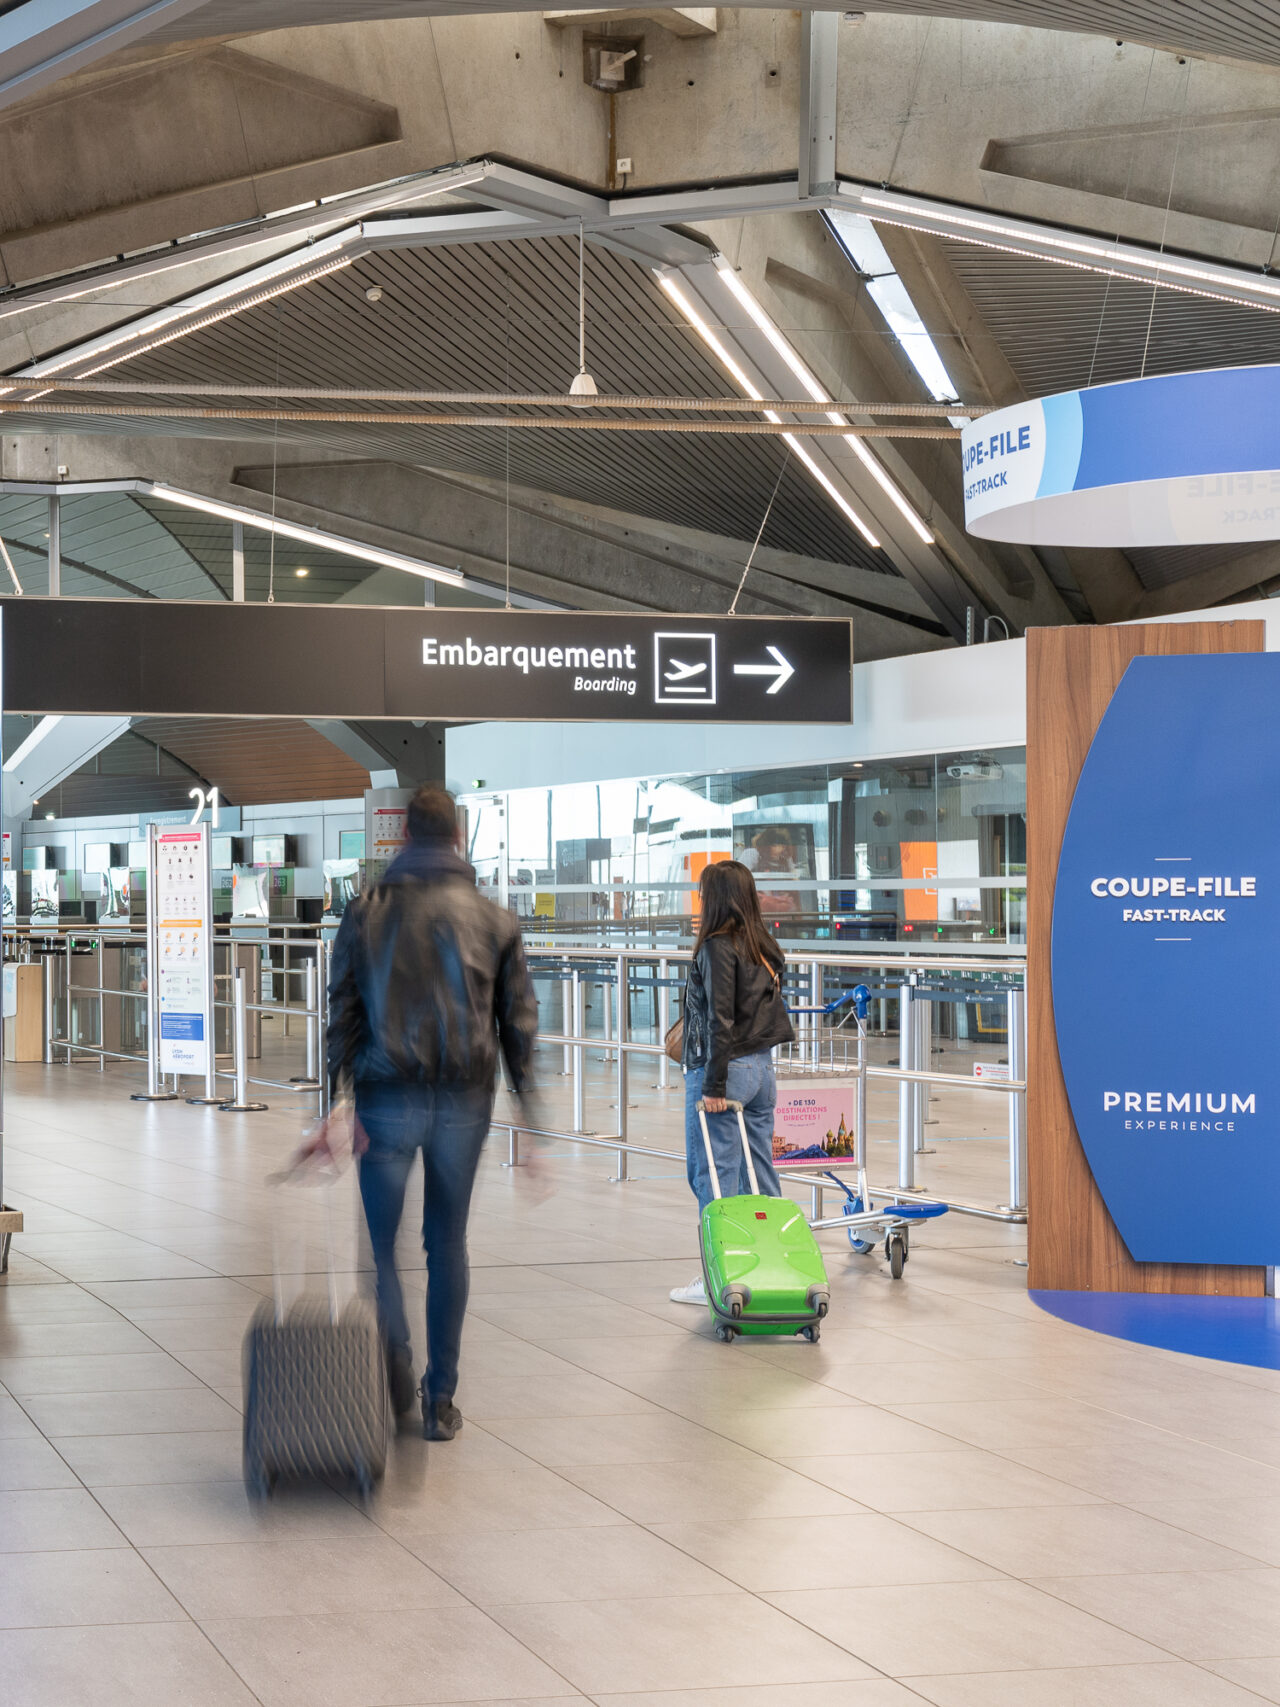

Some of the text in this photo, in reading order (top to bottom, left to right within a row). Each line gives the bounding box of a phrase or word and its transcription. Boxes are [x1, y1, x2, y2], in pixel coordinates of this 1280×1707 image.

[962, 426, 1030, 473] UPE-FILE
[422, 637, 636, 674] Embarquement
[574, 676, 636, 694] Boarding
[189, 787, 218, 828] 21
[1090, 876, 1256, 898] COUPE-FILE
[1122, 908, 1226, 922] FAST-TRACK
[1104, 1091, 1256, 1114] PREMIUM
[1124, 1120, 1235, 1132] EXPERIENCE
